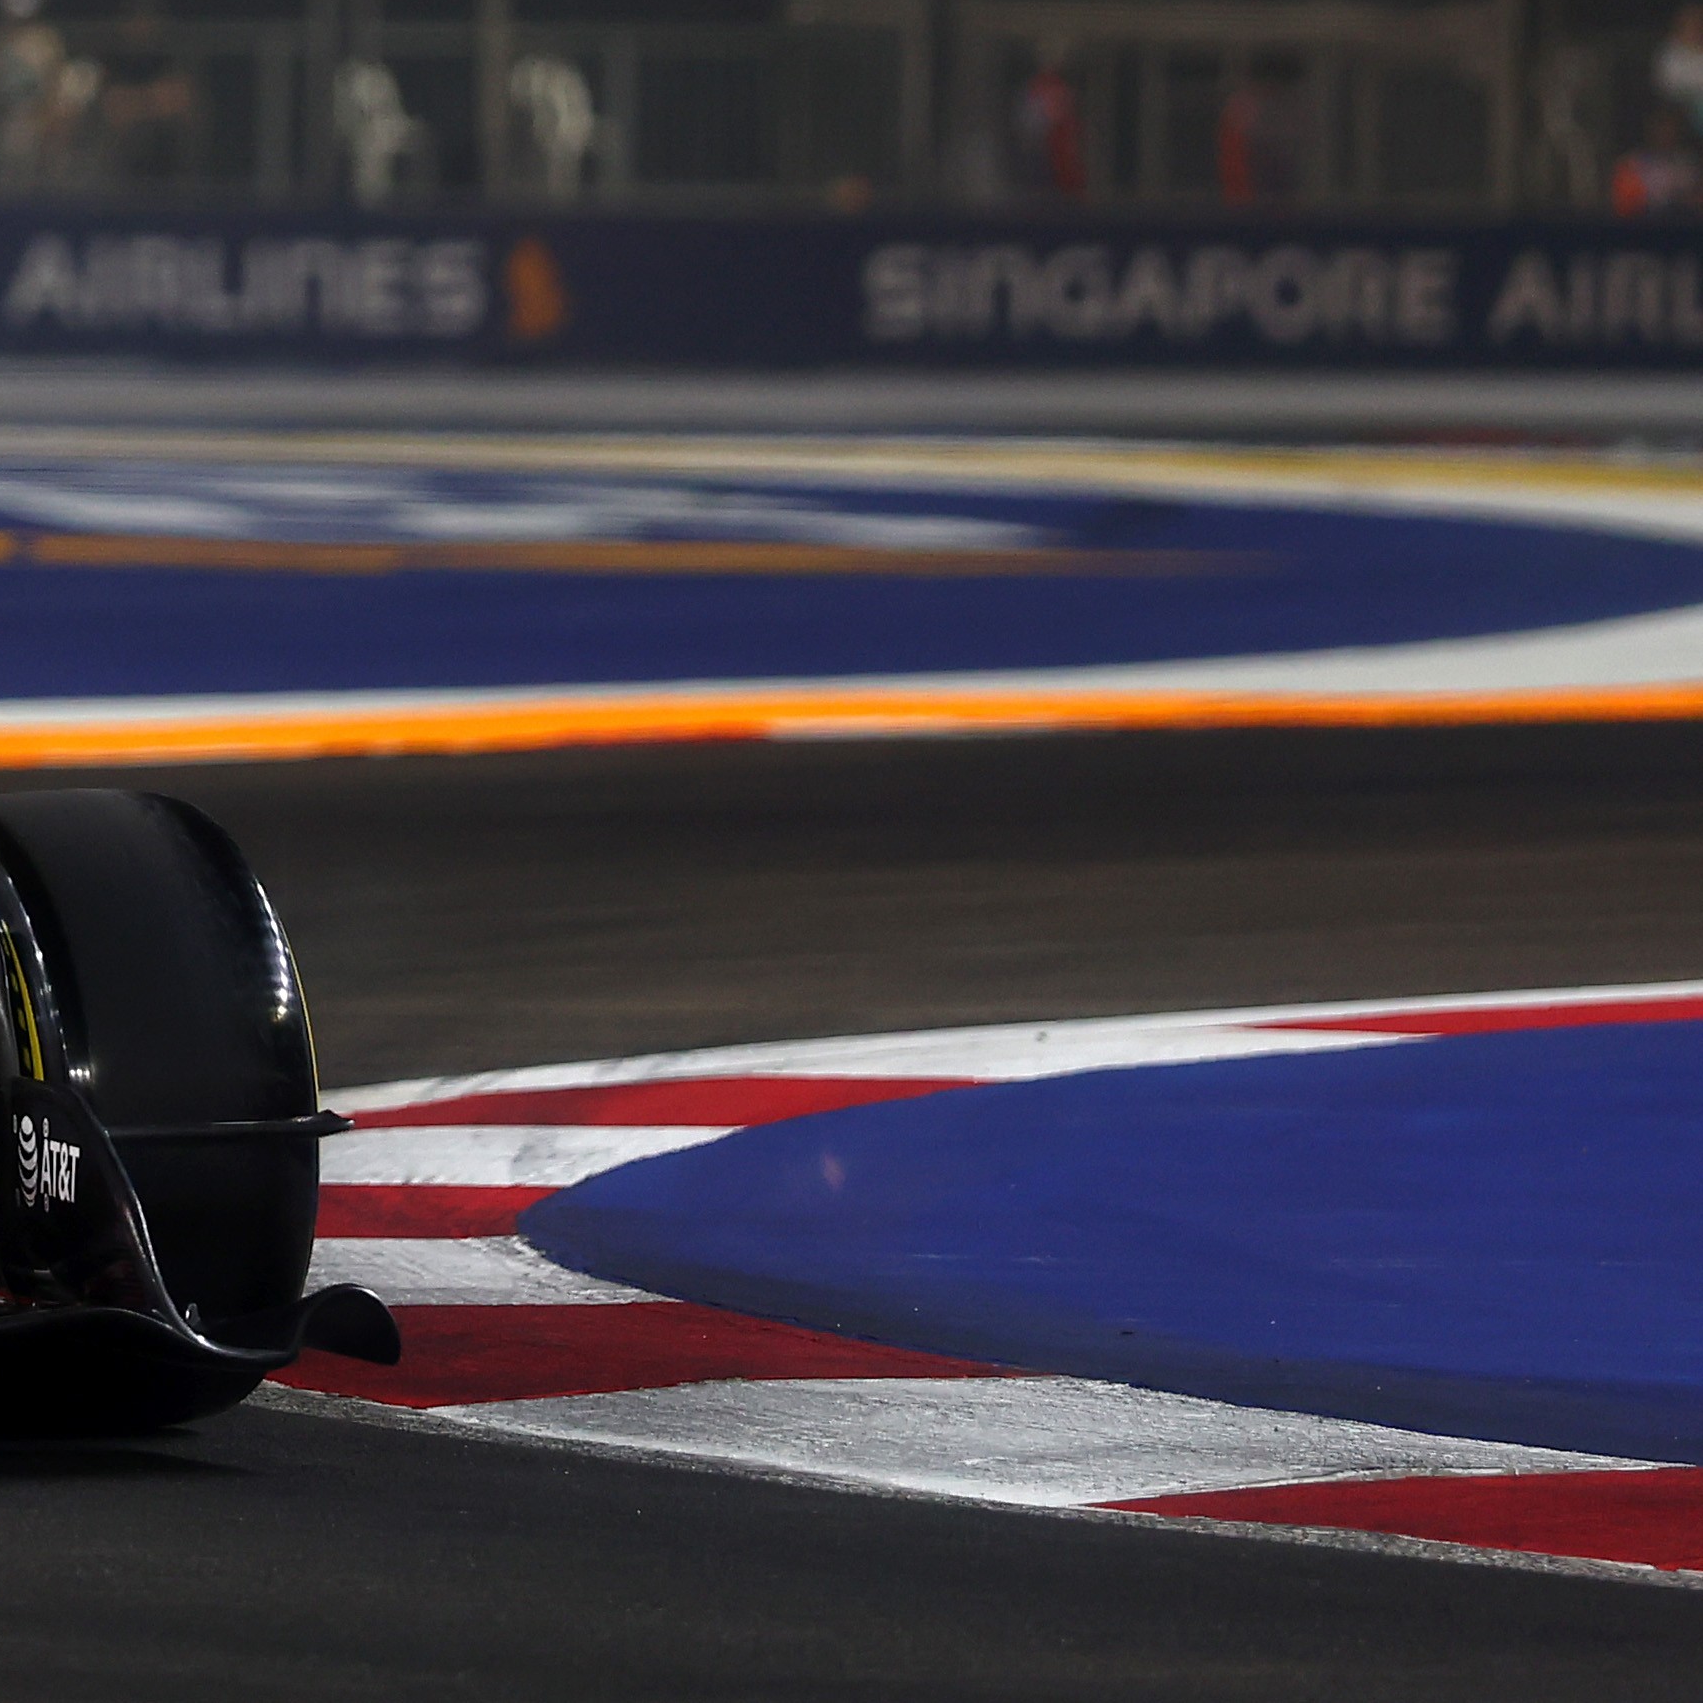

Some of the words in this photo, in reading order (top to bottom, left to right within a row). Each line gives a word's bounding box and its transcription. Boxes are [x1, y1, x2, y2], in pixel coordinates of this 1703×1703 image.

[7, 233, 485, 338] AIRLINES
[862, 241, 1454, 343] SINGAPORE
[40, 1138, 80, 1203] AT&T
